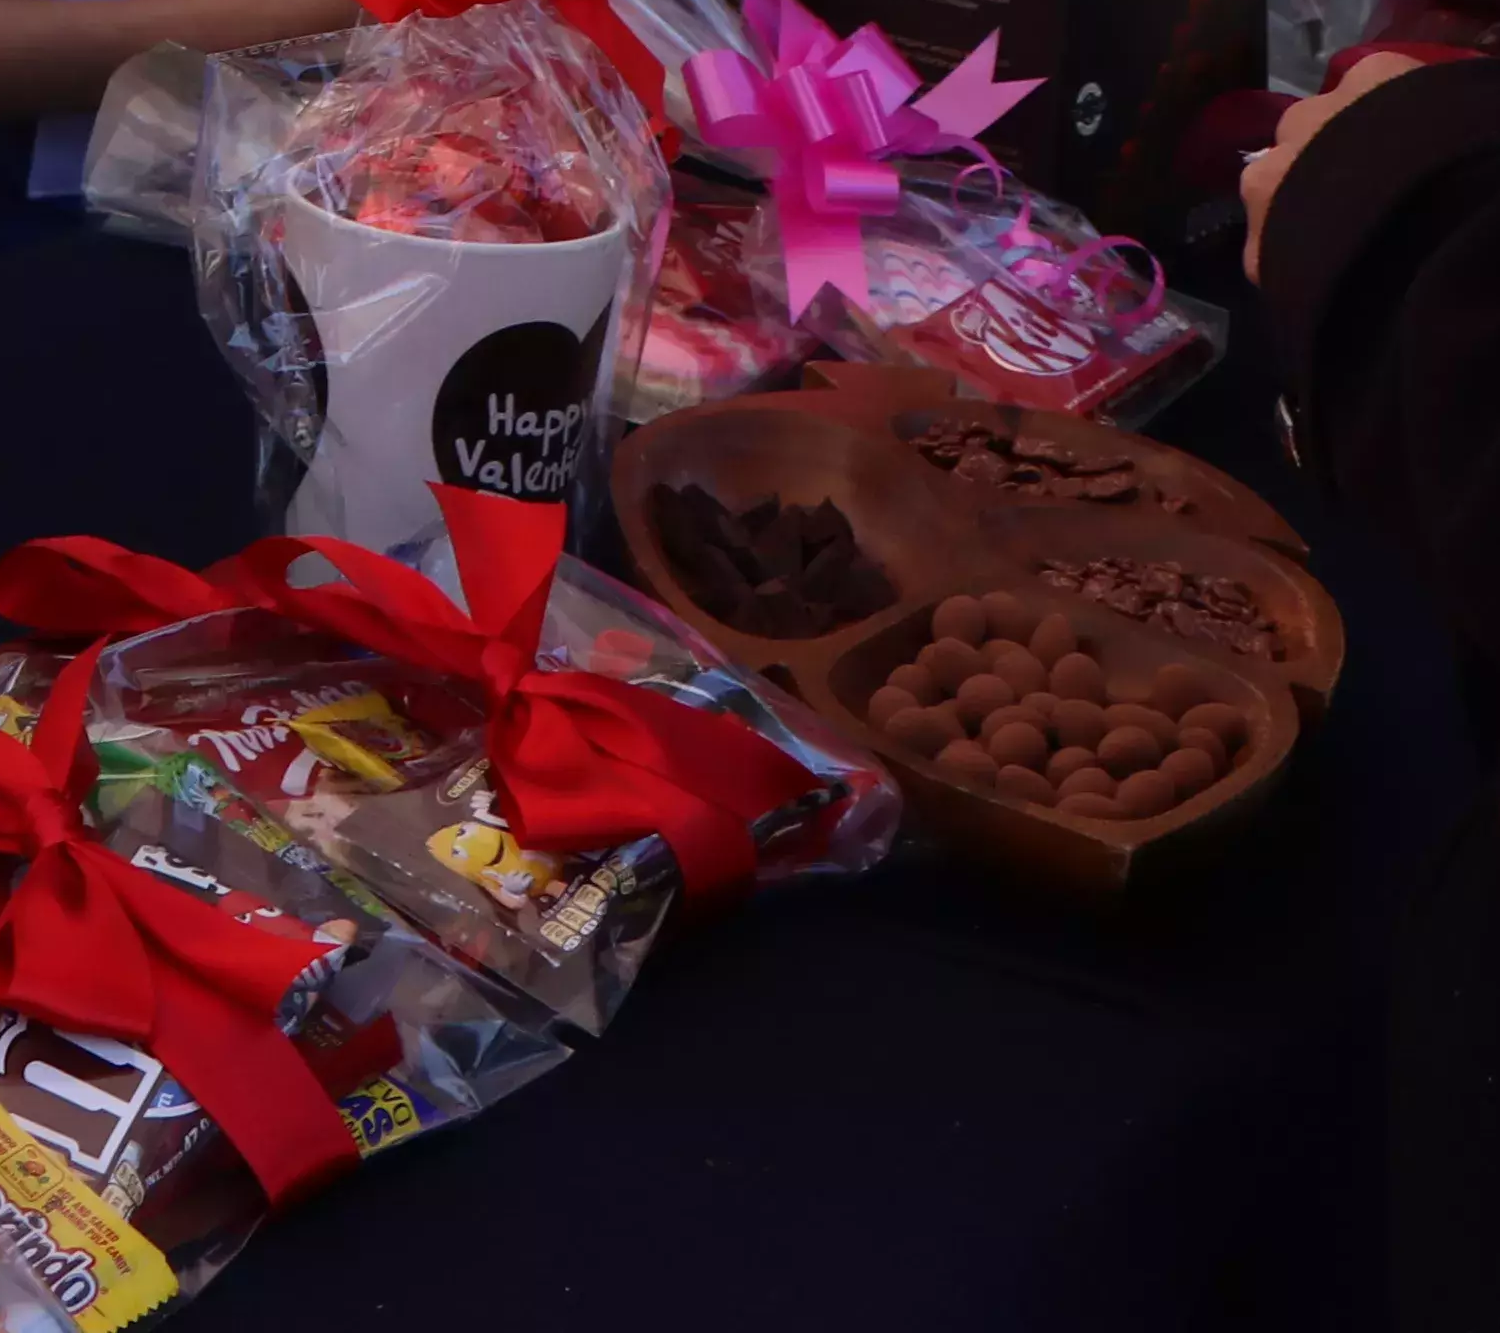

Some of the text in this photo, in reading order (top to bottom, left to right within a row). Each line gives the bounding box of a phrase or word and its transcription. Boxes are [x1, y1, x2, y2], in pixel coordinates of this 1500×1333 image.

[455, 435, 588, 494] Valenti
[84, 1226, 109, 1250] PULP
[105, 1244, 132, 1276] CANDY
